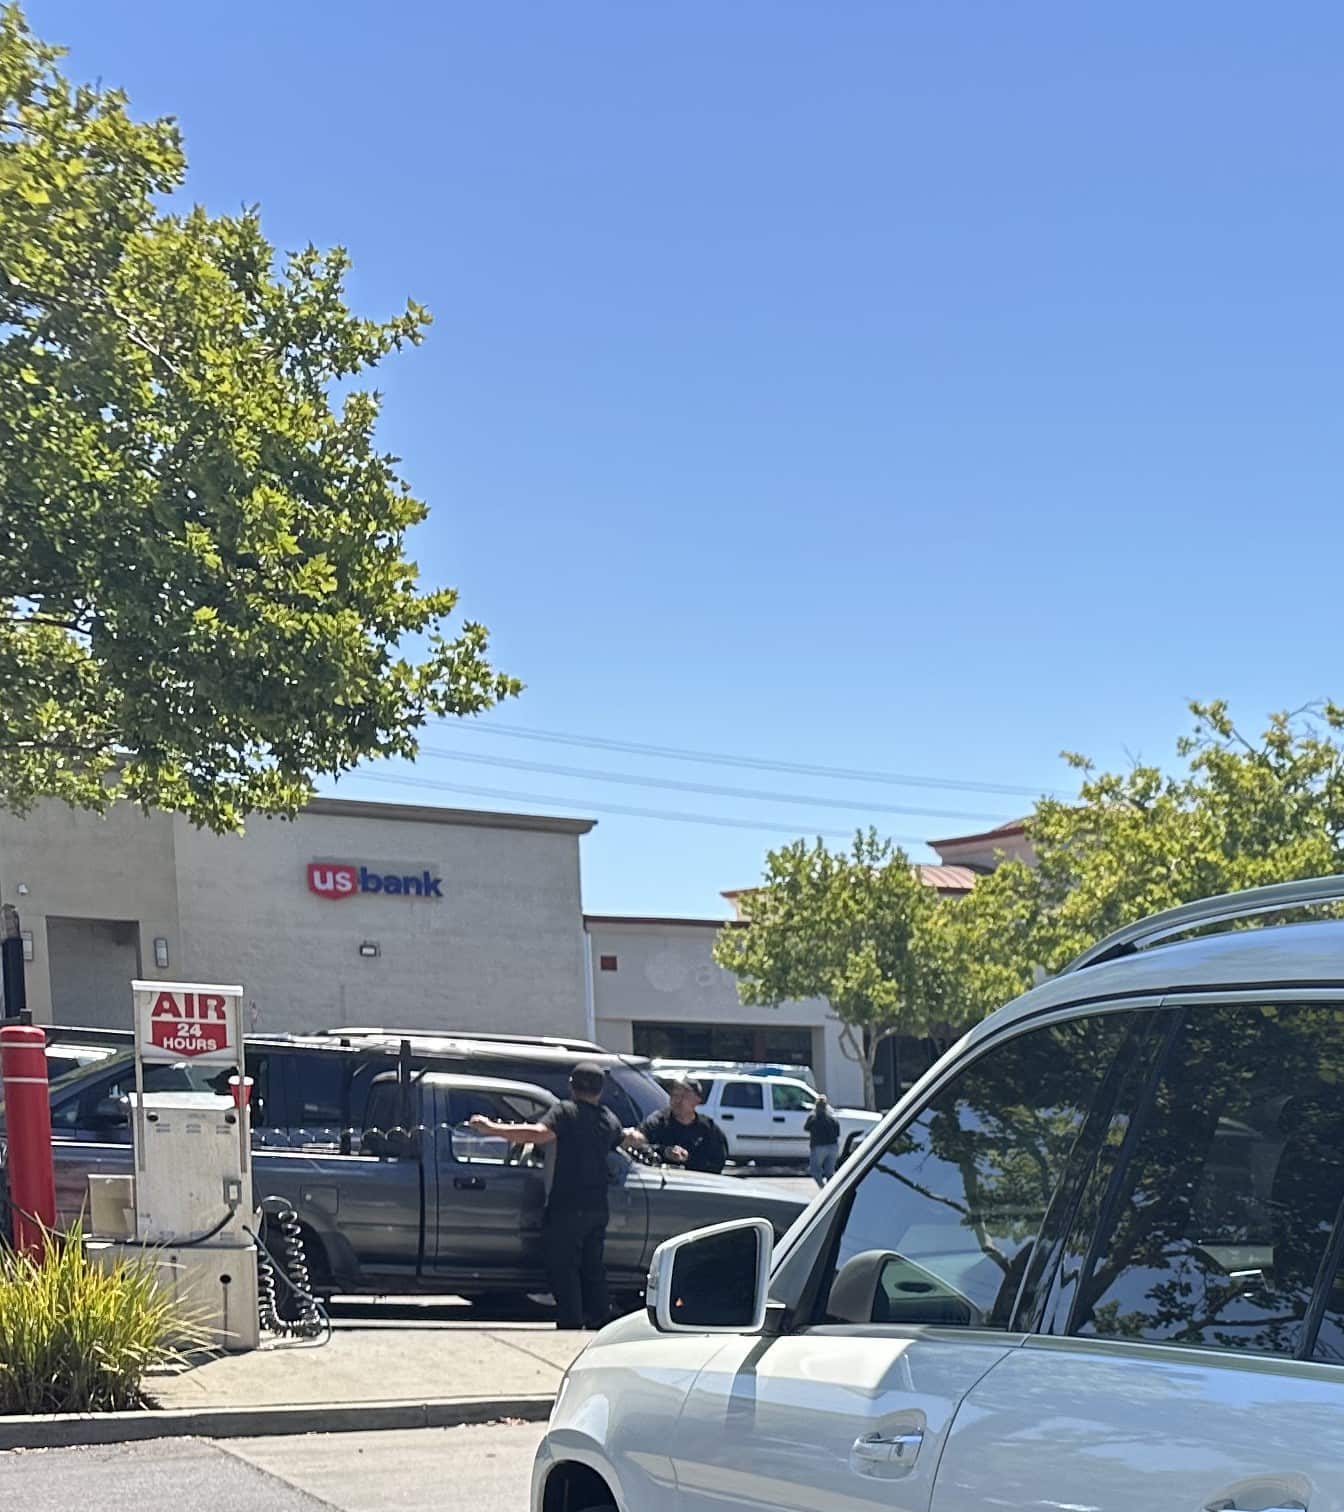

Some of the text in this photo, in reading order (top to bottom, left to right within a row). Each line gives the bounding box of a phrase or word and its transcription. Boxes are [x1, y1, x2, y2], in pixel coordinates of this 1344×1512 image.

[151, 991, 227, 1021] AIR
[177, 1023, 203, 1038] 24
[163, 1037, 218, 1051] HOURS
